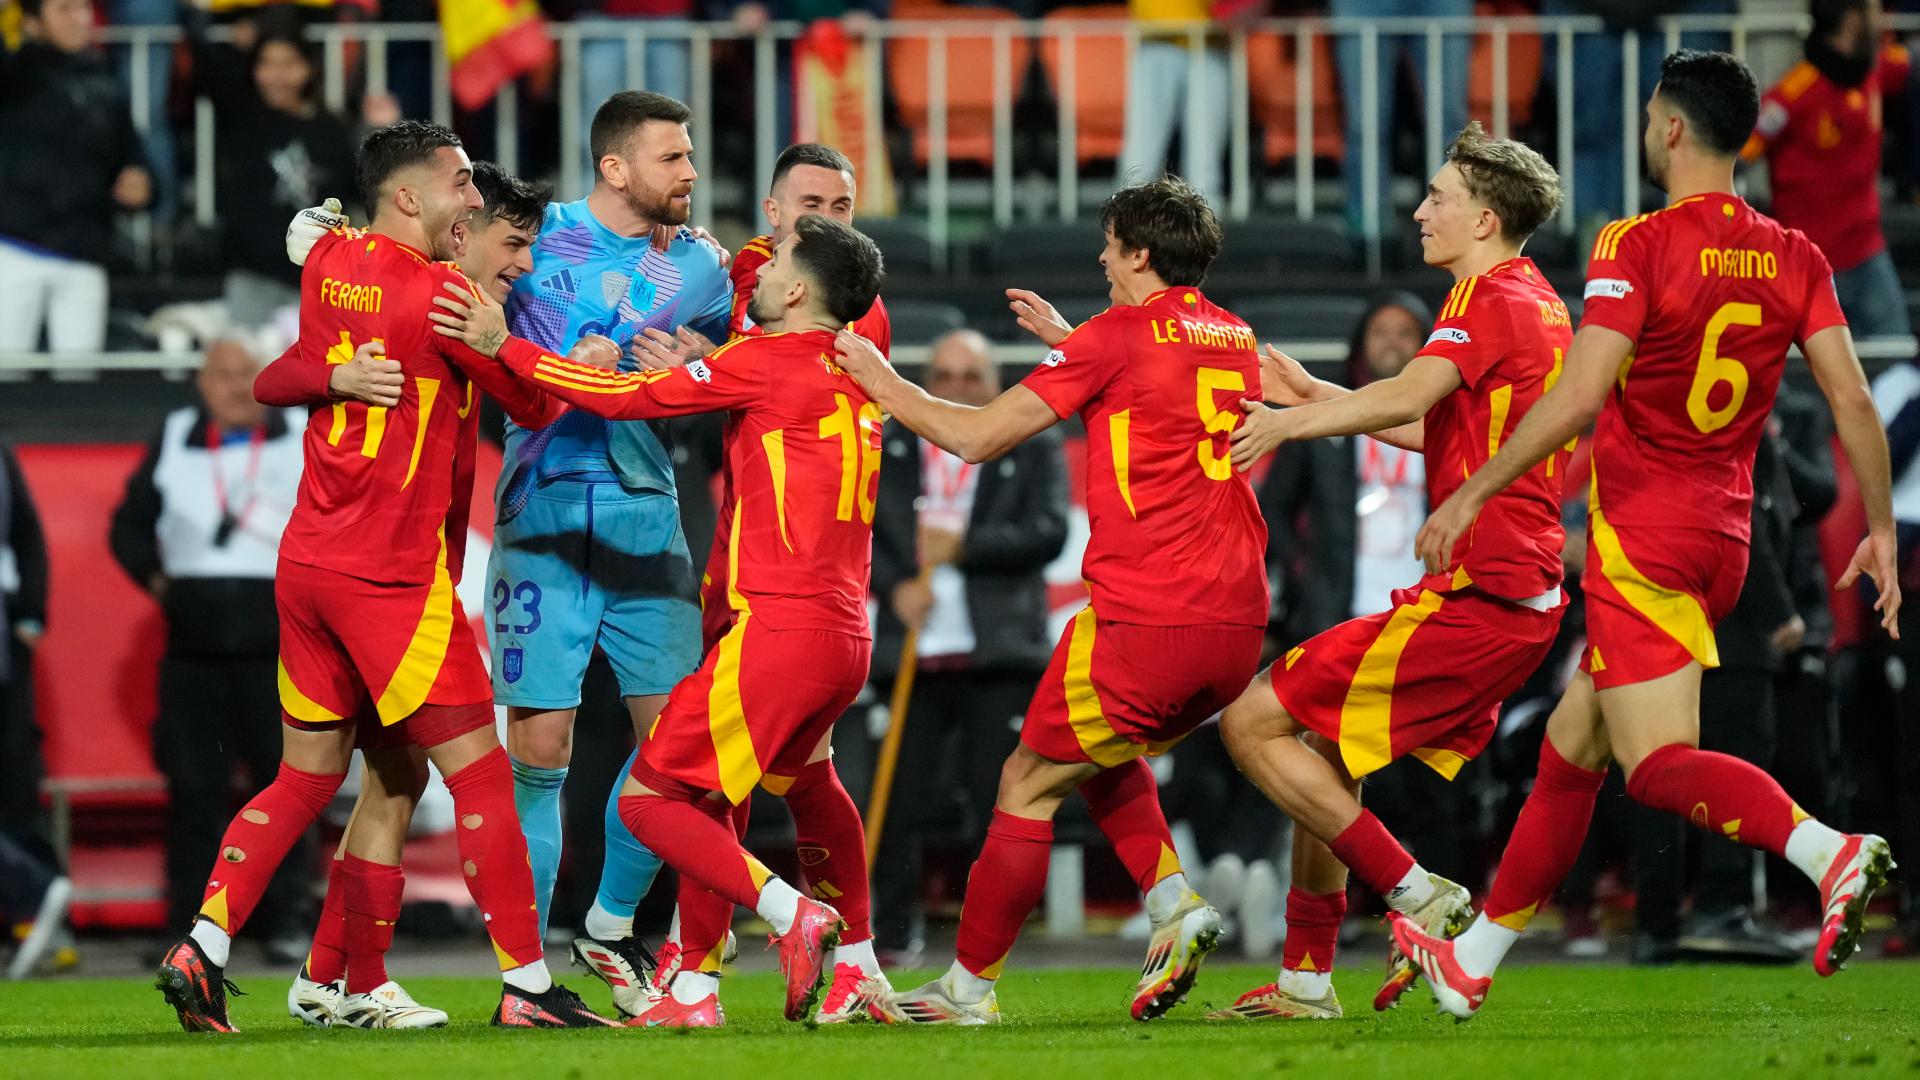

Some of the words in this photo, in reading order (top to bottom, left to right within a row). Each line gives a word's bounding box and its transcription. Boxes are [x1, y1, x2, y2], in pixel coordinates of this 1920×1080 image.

[302, 210, 344, 227] reusch
[320, 277, 383, 313] FERRAN
[1150, 319, 1181, 344] LE
[1686, 302, 1762, 434] 6
[1196, 367, 1246, 481] 5
[493, 578, 542, 634] 23
